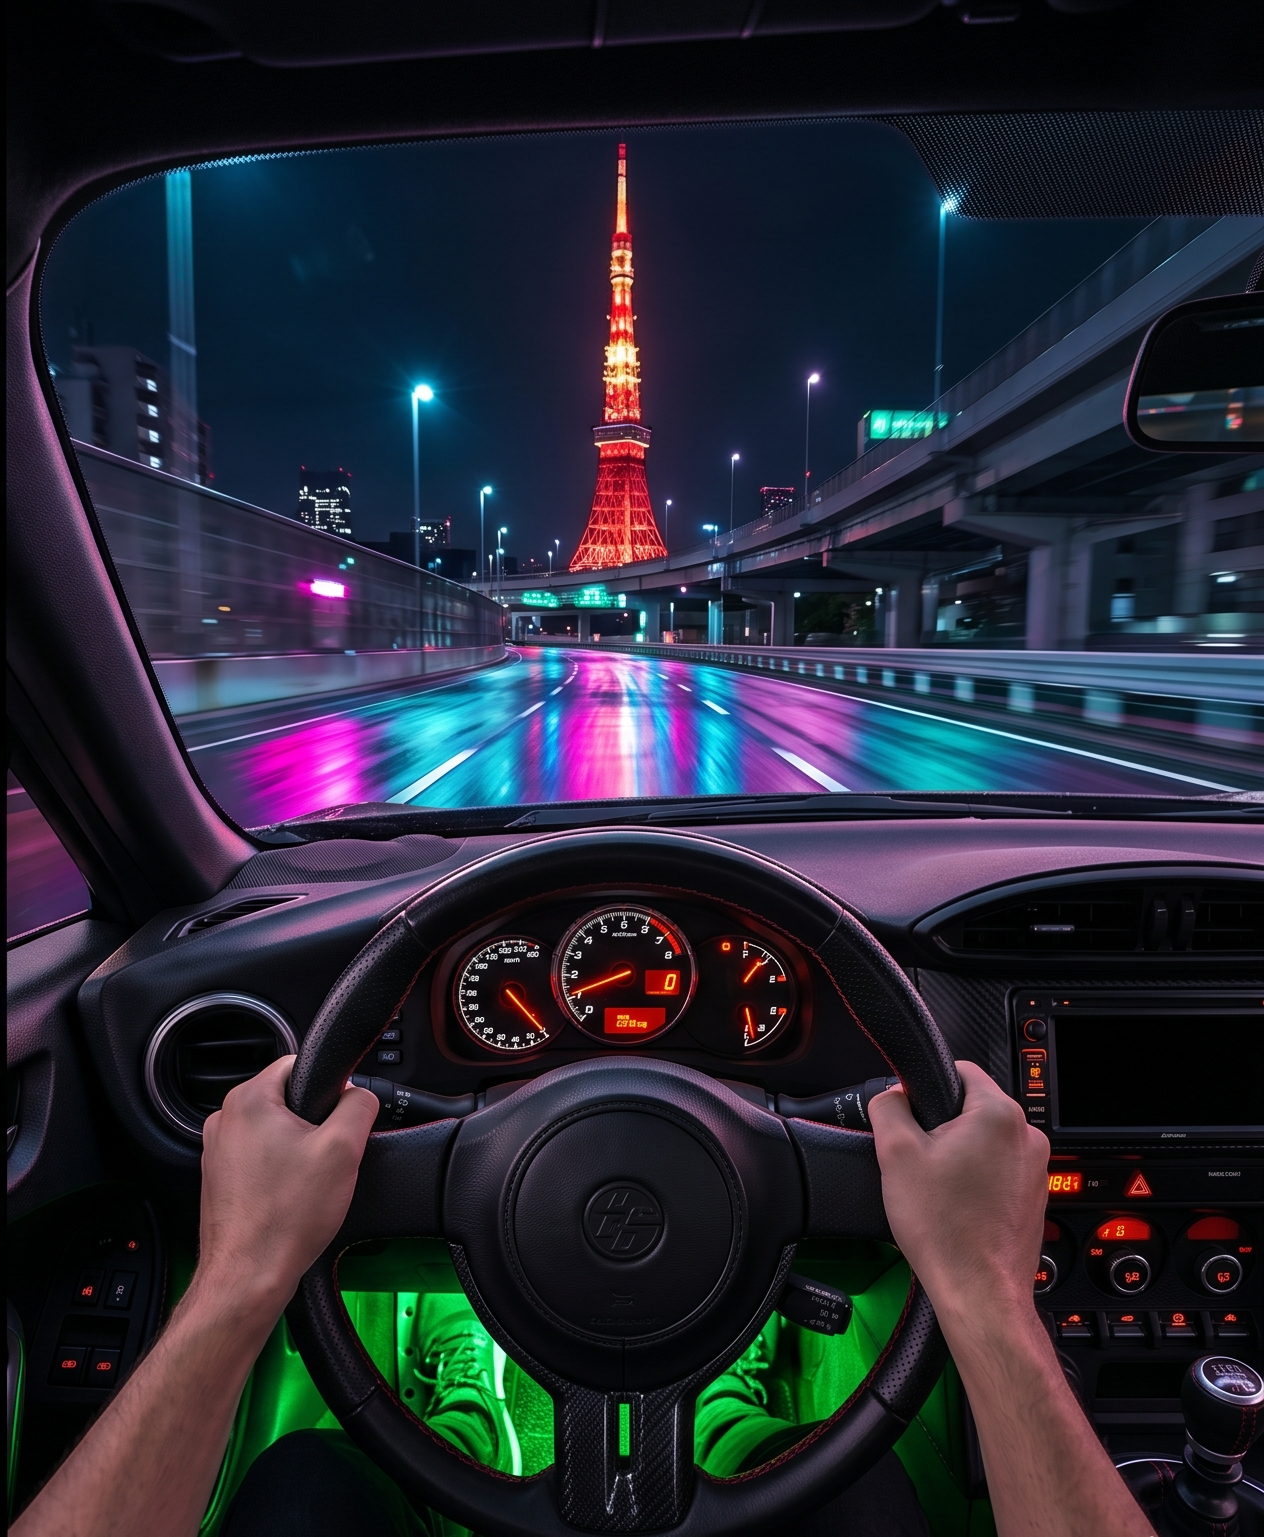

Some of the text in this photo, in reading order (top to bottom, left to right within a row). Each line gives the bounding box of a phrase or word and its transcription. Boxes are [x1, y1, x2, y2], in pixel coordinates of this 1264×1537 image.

[620, 921, 628, 929] 6
[600, 925, 608, 934] 5
[584, 936, 593, 944] 4
[574, 951, 582, 959] 3
[664, 951, 673, 959] 8
[571, 970, 579, 979] 2
[664, 973, 677, 990] 0
[585, 1005, 594, 1014] 0
